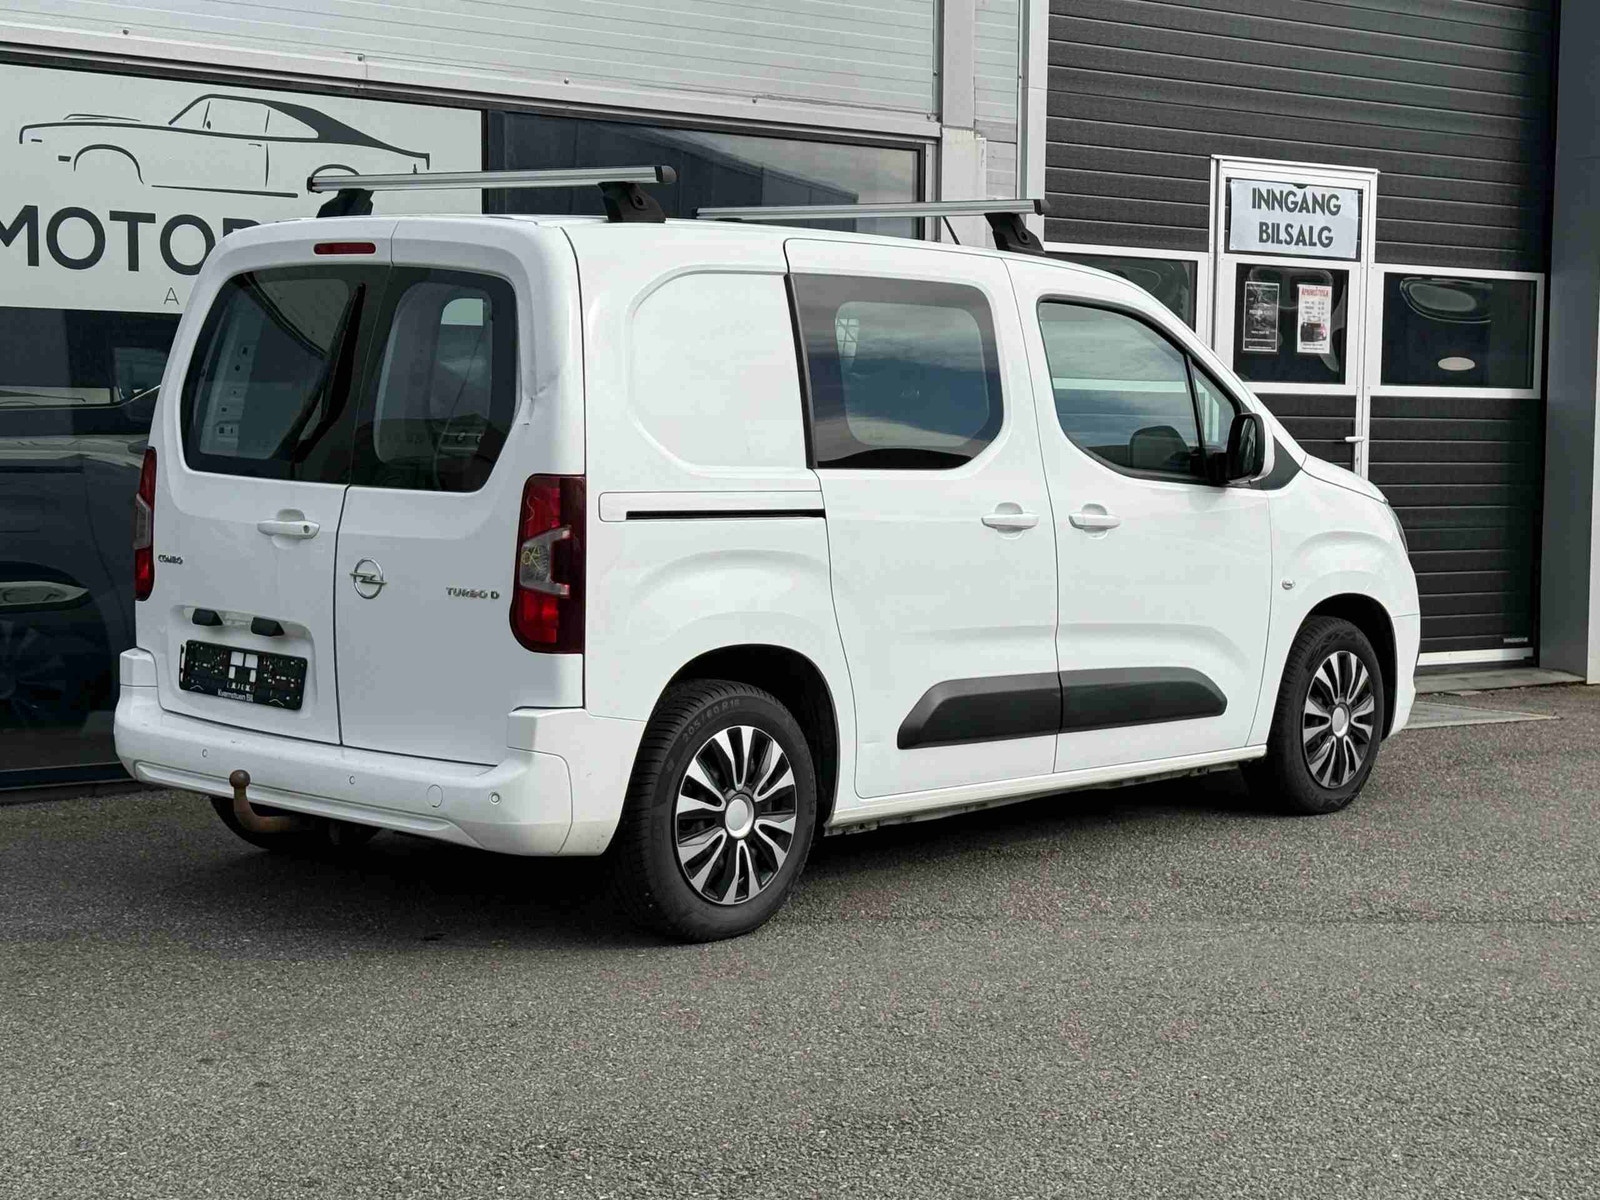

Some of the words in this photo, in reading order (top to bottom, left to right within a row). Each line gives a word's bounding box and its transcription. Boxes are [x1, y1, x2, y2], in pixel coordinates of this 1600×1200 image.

[1251, 187, 1342, 216] INNGANG
[0, 204, 262, 276] MOTO
[1258, 221, 1334, 248] BILSALG
[446, 587, 488, 599] TURBO
[490, 590, 500, 599] D
